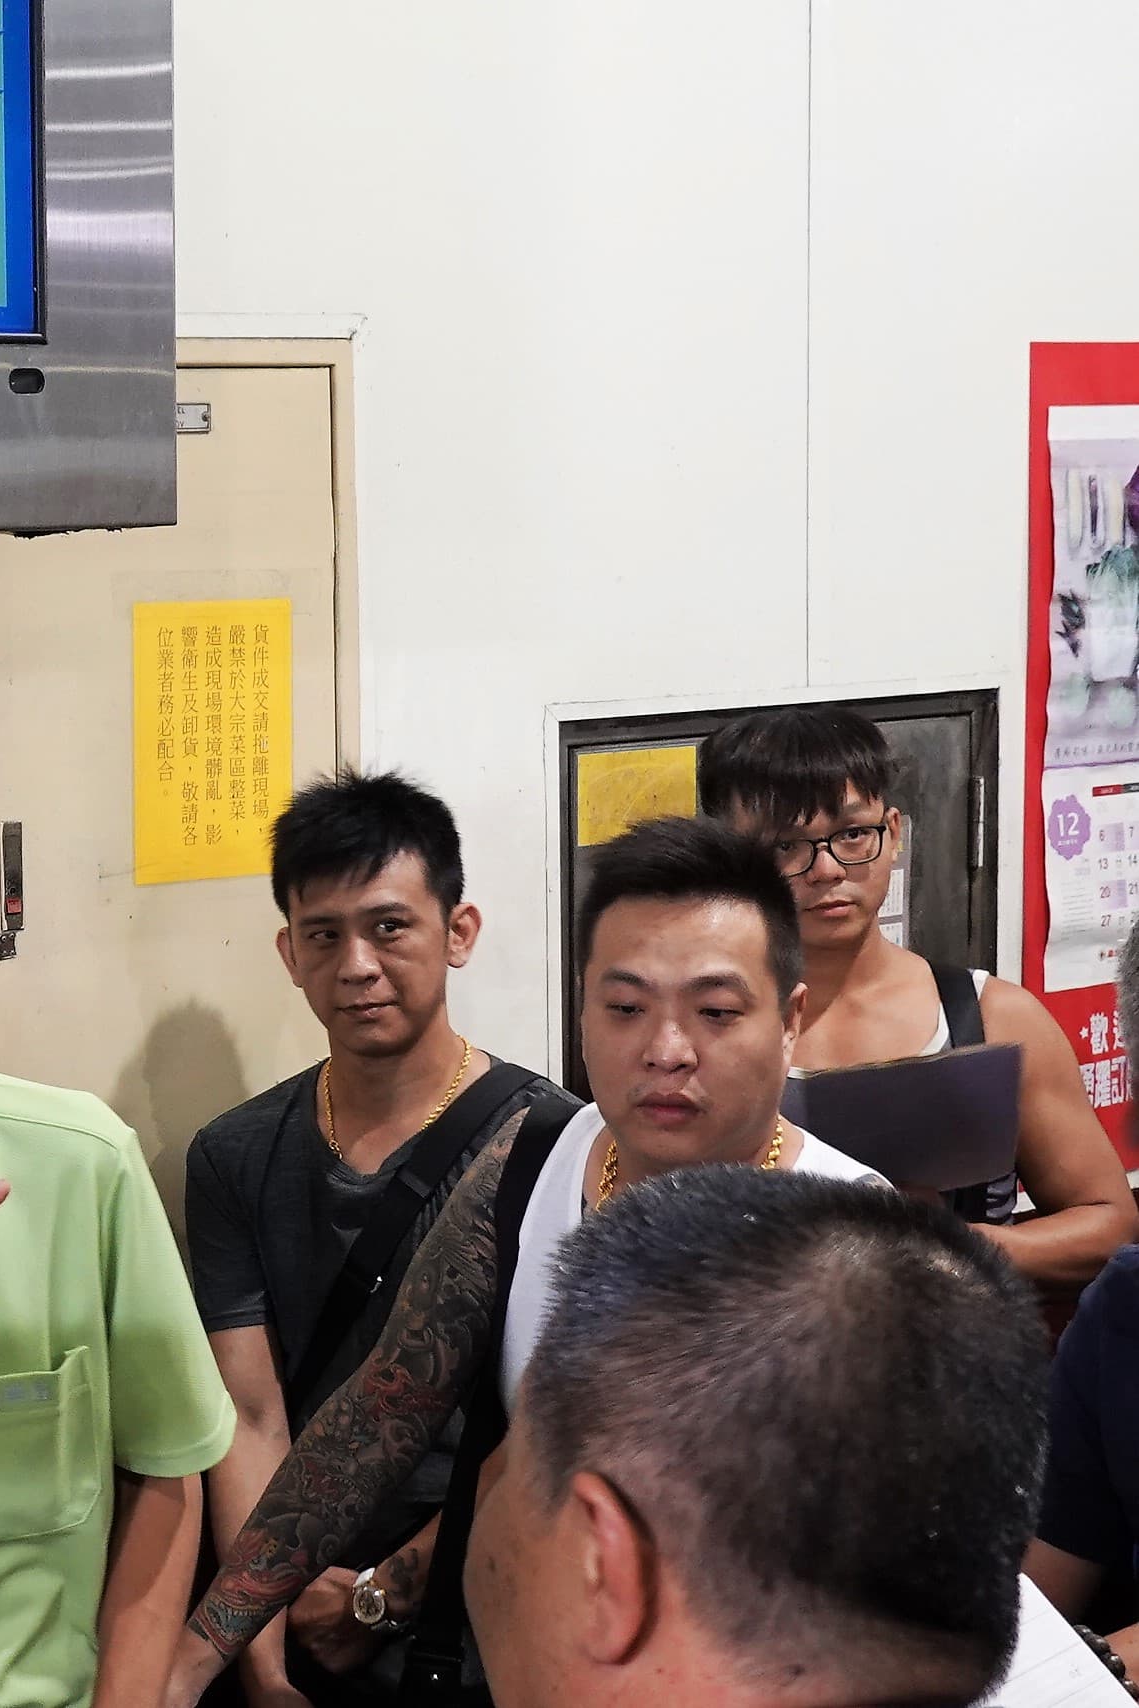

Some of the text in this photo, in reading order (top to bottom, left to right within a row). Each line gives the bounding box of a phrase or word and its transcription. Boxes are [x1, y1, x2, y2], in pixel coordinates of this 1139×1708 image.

[1057, 812, 1080, 837] 12
[1098, 858, 1109, 870] 13
[1100, 886, 1111, 899] 20
[1101, 914, 1111, 927] 27
